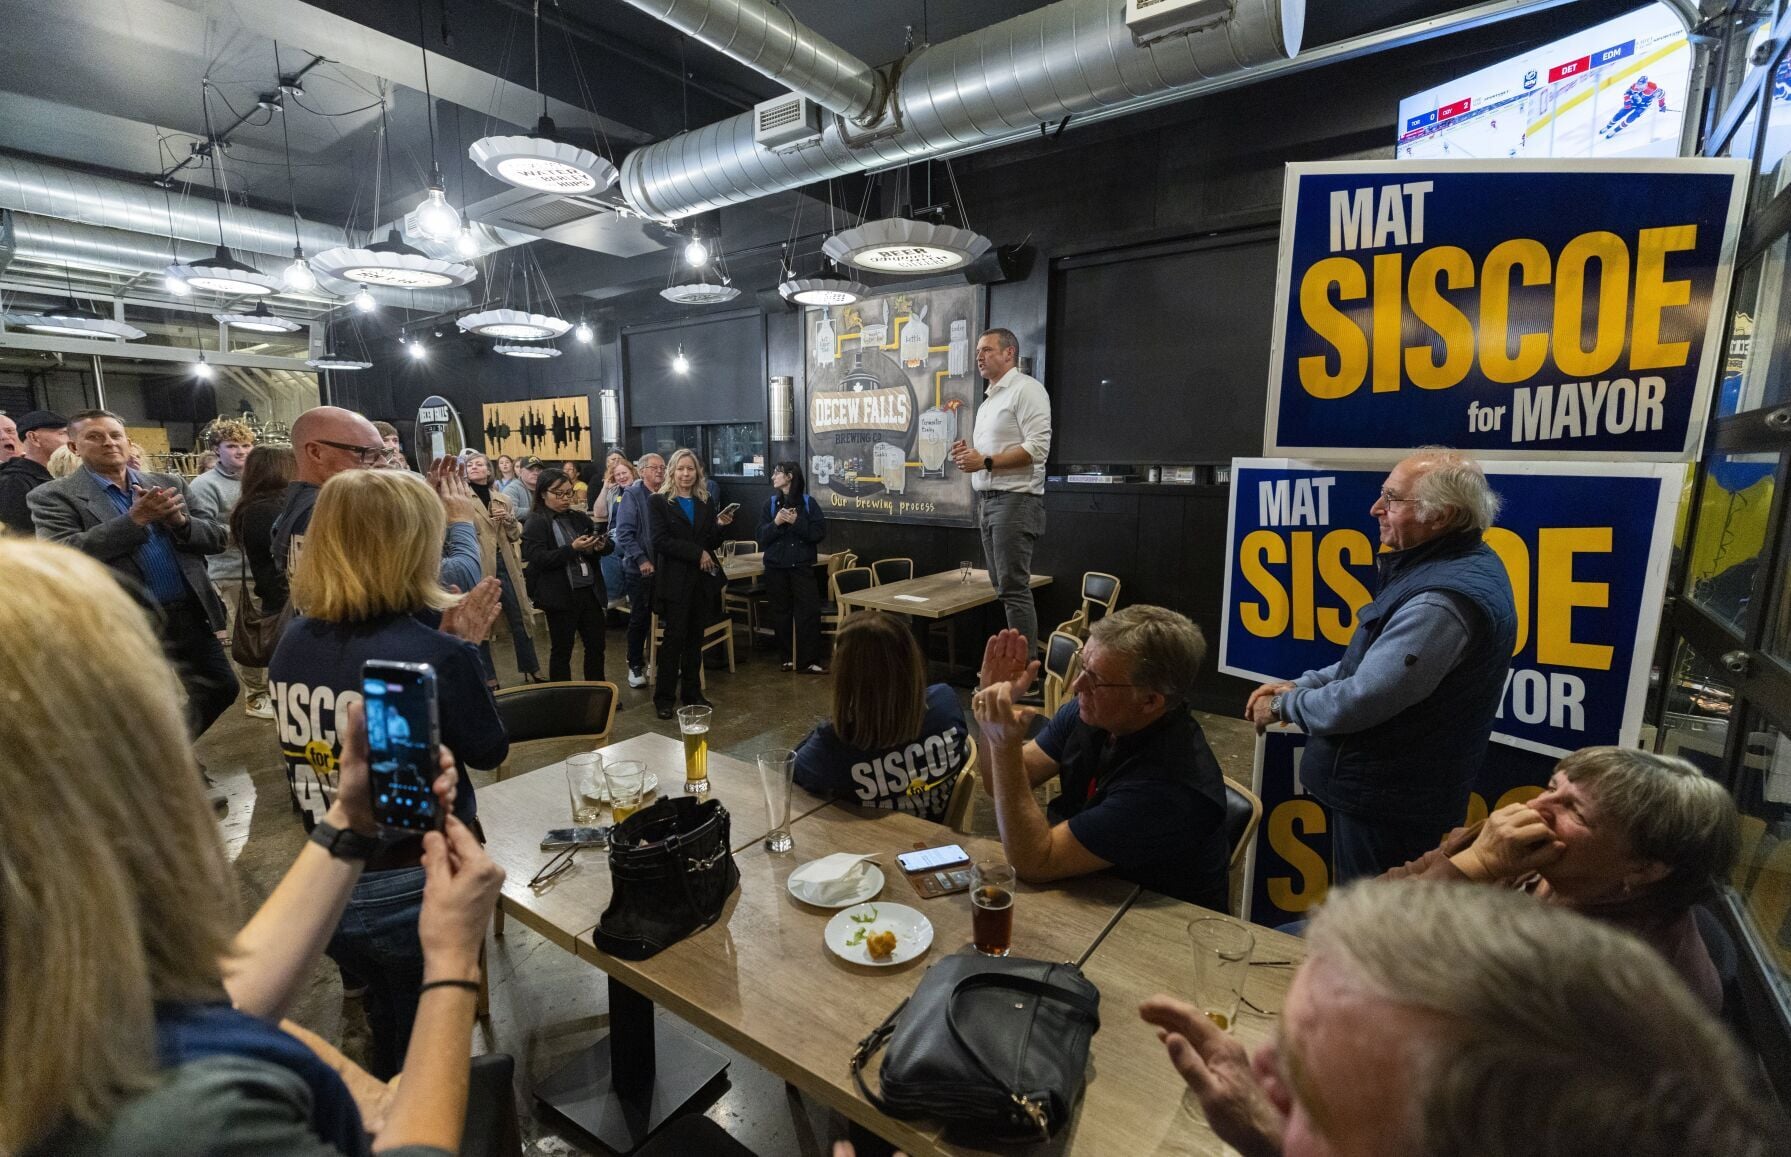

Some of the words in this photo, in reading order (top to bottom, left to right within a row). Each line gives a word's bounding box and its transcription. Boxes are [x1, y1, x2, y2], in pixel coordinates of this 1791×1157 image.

[1561, 63, 1577, 75] DET
[1602, 47, 1621, 61] EDM
[1463, 101, 1469, 109] 2
[518, 168, 578, 176] WATER
[1329, 180, 1434, 252] MAT
[878, 247, 928, 257] BEER
[1298, 224, 1698, 400] SISCOE
[815, 397, 860, 427] DECEW
[863, 394, 908, 425] FALLS
[1467, 401, 1507, 434] for
[1512, 376, 1666, 443] MAYOR
[835, 432, 871, 445] BREWING
[831, 493, 848, 507] Our
[856, 496, 893, 515] brewing
[899, 500, 935, 515] process
[1258, 476, 1336, 526] MAT
[310, 747, 330, 768] for
[851, 726, 961, 801] SISCOE
